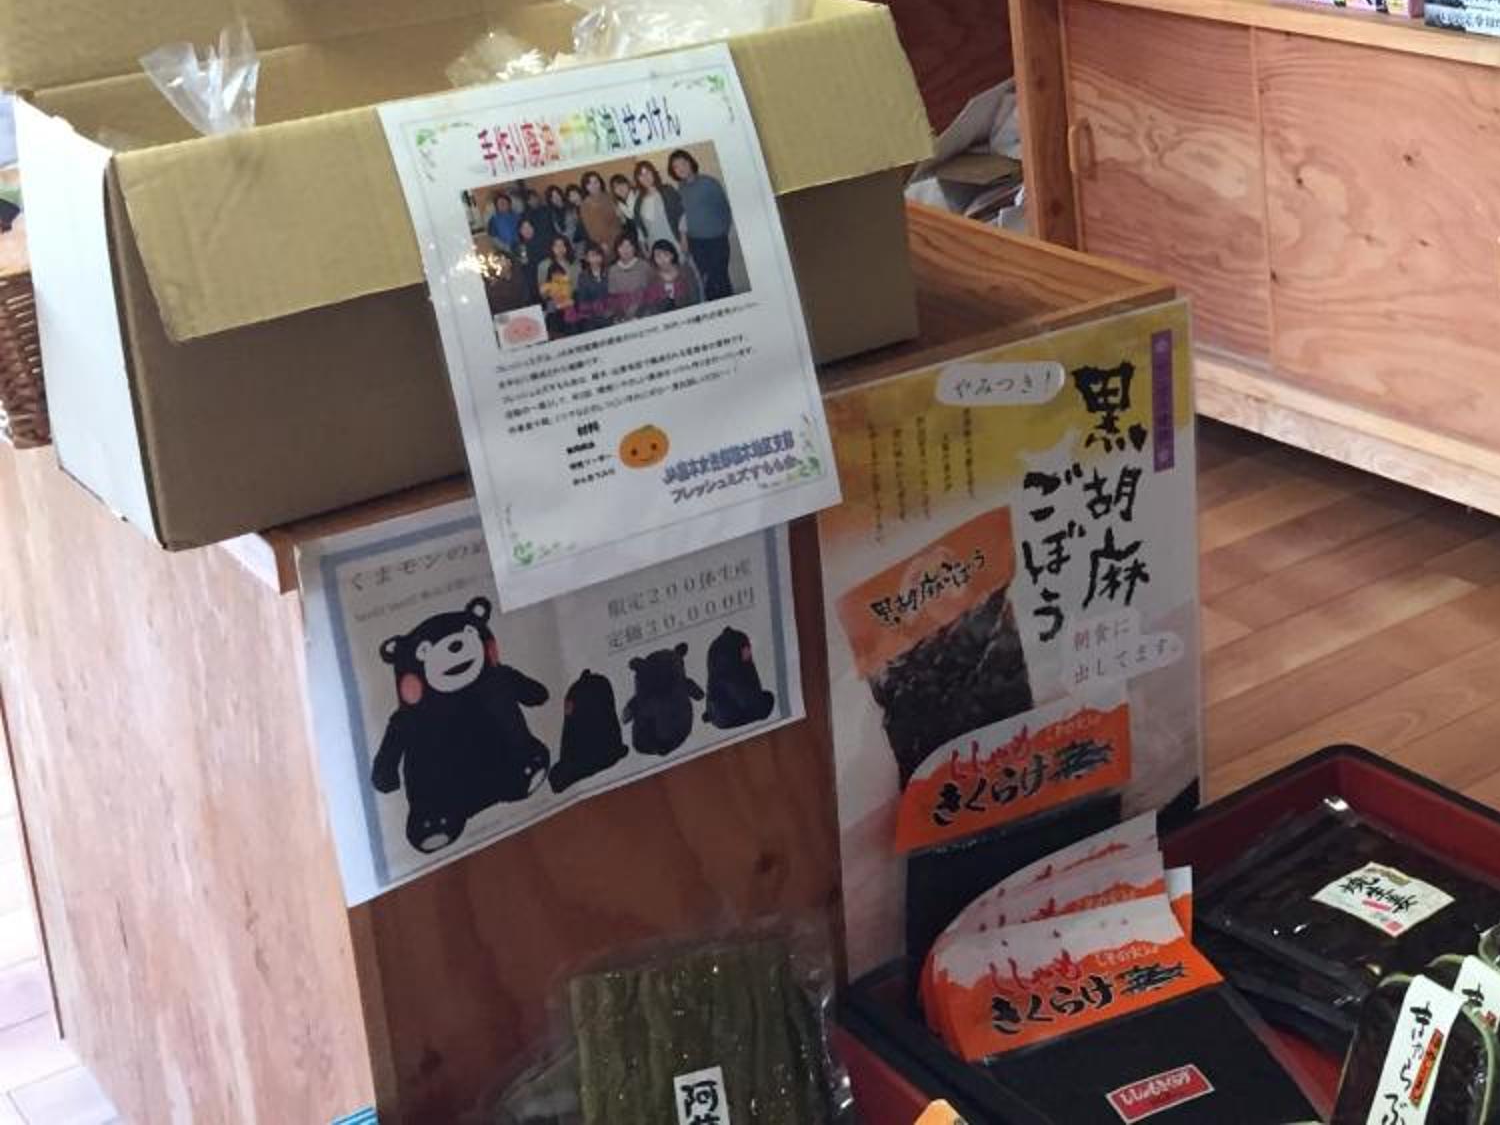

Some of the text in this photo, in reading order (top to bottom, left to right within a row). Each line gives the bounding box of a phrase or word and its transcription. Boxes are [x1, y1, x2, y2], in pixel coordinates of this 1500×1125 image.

[1021, 461, 1086, 642] ごぼう
[1072, 362, 1150, 609] 黒胡麻
